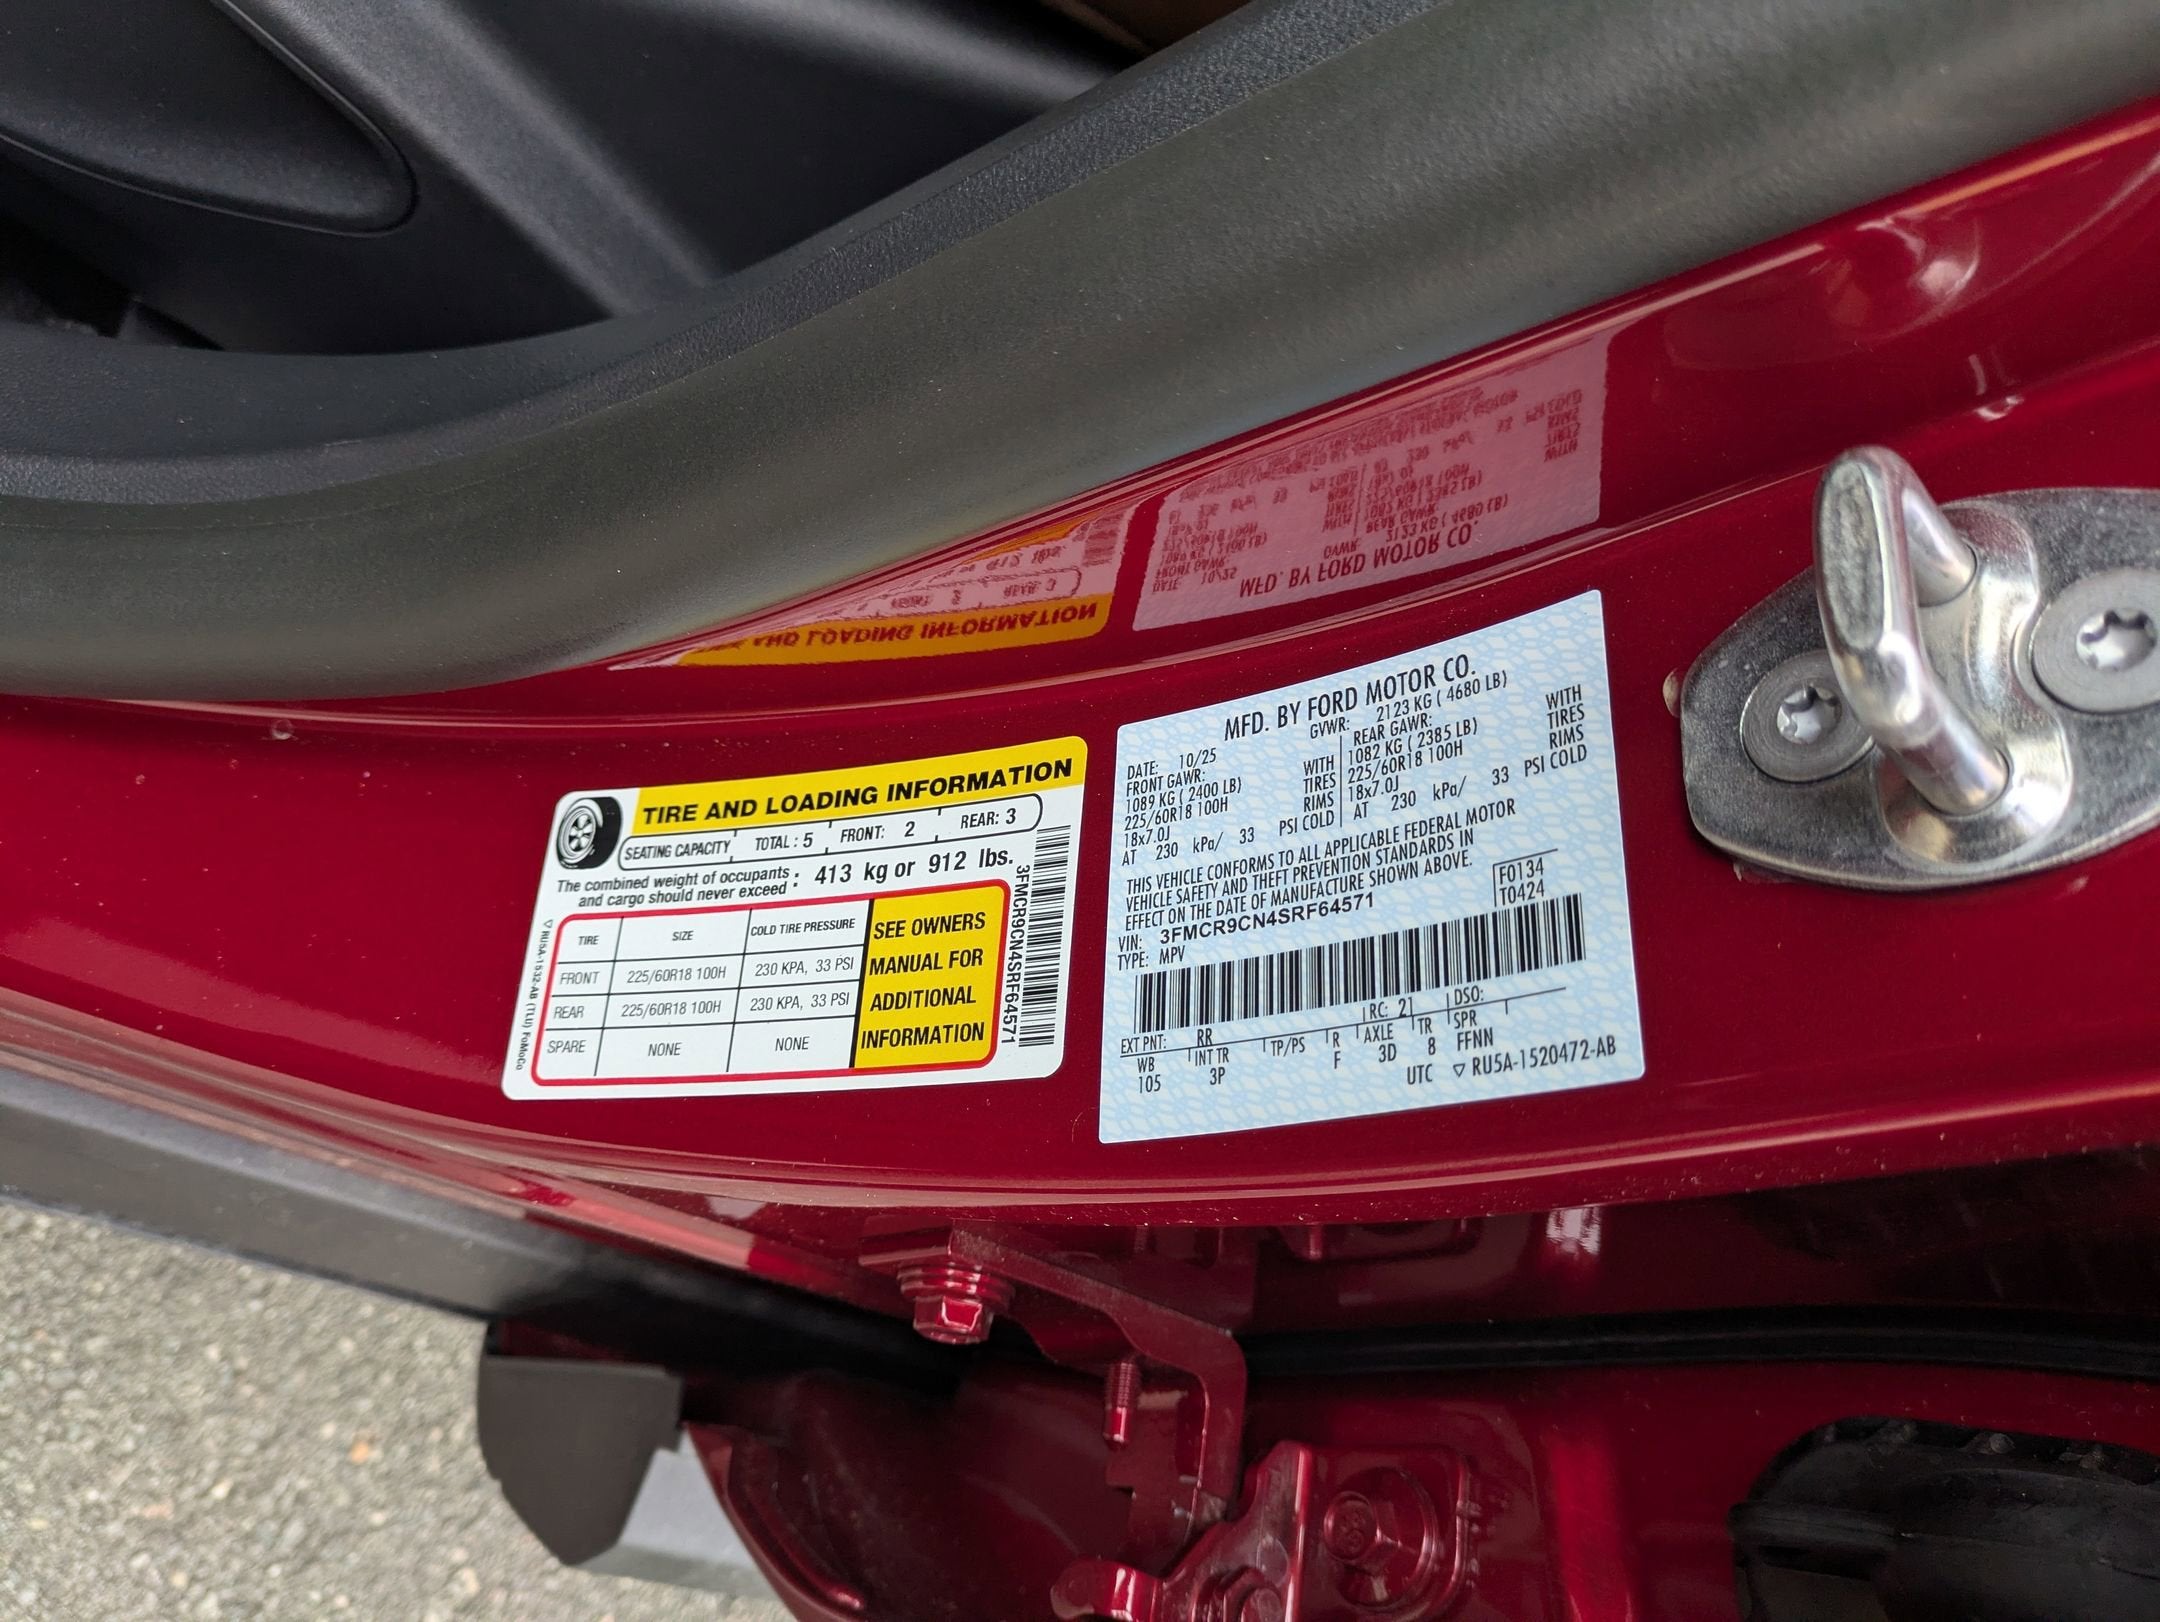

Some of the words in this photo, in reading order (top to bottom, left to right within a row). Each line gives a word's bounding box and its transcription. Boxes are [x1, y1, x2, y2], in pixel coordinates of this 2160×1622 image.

[1224, 711, 1269, 741] MFD.
[1278, 701, 1301, 728] BY
[1308, 687, 1358, 721] FORD
[1366, 664, 1435, 705] MOTOR
[1443, 654, 1476, 682] CO.
[1310, 717, 1350, 739] GVWR:
[1377, 701, 1410, 723] 2123
[1414, 694, 1432, 710] KG
[1486, 670, 1507, 689] LB)
[1349, 745, 1380, 766] 1082
[1385, 738, 1402, 754] KG
[1456, 717, 1477, 739] LB)
[1546, 684, 1582, 710] WITH
[1353, 724, 1385, 747] REAR
[1390, 715, 1432, 738] GAWR:
[1348, 750, 1423, 784] 225/60R18
[1429, 739, 1463, 763] 100H
[1547, 703, 1584, 730] TIRES
[1128, 761, 1158, 780] DATE:
[1180, 748, 1216, 769] 10/25
[1349, 775, 1400, 802] 18x7.0J
[1549, 724, 1584, 750] RIMS
[1127, 776, 1164, 797] FRONT
[1167, 770, 1205, 788] GAWR:
[1127, 795, 1155, 814] 1089
[1159, 792, 1176, 807] KG
[1223, 777, 1241, 794] LB)
[1303, 755, 1335, 776] WITH
[1391, 791, 1416, 811] 230
[1433, 776, 1466, 800] kPa/
[1492, 767, 1509, 786] 33
[1524, 756, 1545, 777] PSI
[1549, 744, 1587, 769] COLD
[643, 804, 699, 824] TIRE
[705, 800, 757, 820] AND
[765, 786, 878, 815] LOADING
[887, 758, 1072, 802] INFORMATION
[1124, 805, 1192, 831] 225/60R18
[1199, 799, 1228, 816] 100H
[1303, 773, 1336, 794] TIRES
[961, 811, 999, 829] REAR:
[1006, 808, 1016, 824] 3
[1125, 827, 1170, 848] 18x7.0J
[1303, 792, 1334, 812] RIMS
[803, 833, 813, 848] 5
[840, 825, 884, 843] FRONT:
[904, 821, 915, 837] 2
[1156, 842, 1178, 860] 230
[1193, 832, 1223, 853] kPa/
[1239, 827, 1255, 844] 33
[1279, 816, 1298, 836] PSI
[1303, 810, 1335, 831] COLD
[625, 845, 673, 861] SEATING
[675, 840, 731, 857] CAPACITY
[1127, 877, 1152, 895] THIS
[1157, 867, 1203, 889] VEHICLE
[1207, 853, 1274, 881] CONFORMS
[1278, 851, 1294, 866] TO
[1299, 845, 1320, 864] ALL
[1324, 825, 1400, 860] APPLICABLE
[1404, 812, 1461, 841] FEDERAL
[1466, 798, 1515, 825] MOTOR
[557, 880, 581, 892] The
[584, 876, 648, 890] combined
[654, 873, 699, 889] weight
[703, 871, 717, 884] of
[719, 866, 790, 885] occupants
[815, 863, 852, 885] 413
[864, 861, 888, 883] kg
[895, 860, 915, 878] or
[929, 851, 967, 873] 912
[979, 848, 1013, 868] lbs.
[1126, 890, 1172, 913] VEHICLE
[1176, 882, 1218, 904] SAFETY
[1222, 876, 1247, 896] AND
[1253, 869, 1288, 890] THEFT
[1293, 849, 1371, 883] PREVENTION
[1375, 834, 1455, 865] STANDARDS
[1460, 828, 1474, 846] IN
[1500, 858, 1544, 884] F0134
[579, 895, 602, 907] and
[607, 892, 644, 907] cargo
[649, 887, 692, 903] should
[697, 887, 734, 900] never
[739, 881, 787, 897] exceed
[1126, 910, 1163, 931] EFFECT
[1168, 907, 1185, 924] ON
[1190, 902, 1212, 920] THE
[1216, 896, 1246, 916] DATE
[1251, 892, 1267, 910] OF
[1271, 872, 1364, 907] MANUFACTURE
[1369, 861, 1419, 888] SHOWN
[1424, 850, 1472, 876] ABOVE.
[1500, 879, 1545, 905] T0424
[751, 925, 776, 936] COLD
[779, 922, 801, 935] TIRE
[803, 918, 855, 932] PRESSURE
[874, 920, 906, 939] SEE
[911, 912, 985, 936] OWNERS
[1119, 934, 1142, 952] VIN:
[1160, 892, 1373, 944] 3FMCR9CN4SRF64571
[578, 936, 600, 945] TIRE
[672, 931, 693, 941] SIZE
[869, 952, 943, 975] MANUAL
[949, 949, 983, 969] FOR
[1001, 864, 1031, 1044] 3FMCR9CN4SRF64571
[1118, 951, 1149, 971] TYPE:
[1160, 945, 1185, 965] MPV
[560, 971, 600, 985] FRONT
[627, 968, 692, 985] 225/60R18
[696, 967, 726, 980] 100H
[755, 963, 778, 976] 230
[750, 997, 773, 1011] 230
[870, 986, 976, 1012] ADDITIONAL
[1455, 986, 1484, 1005] DSO:
[522, 1002, 536, 1028] (TLU)
[554, 1006, 584, 1018] REAR
[621, 1003, 687, 1019] 225/60R18
[692, 1001, 721, 1014] 100H
[1369, 1002, 1388, 1020] RC:
[1454, 1010, 1477, 1029] SPR
[861, 1022, 985, 1049] INFORMATION
[1121, 1037, 1140, 1054] EXT
[1143, 1035, 1166, 1050] PNT:
[1197, 1029, 1212, 1047] RR
[1364, 1023, 1394, 1044] AXLE
[1457, 1028, 1493, 1051] FFNN
[516, 1032, 531, 1070] FoMoCo
[547, 1040, 586, 1054] SPARE
[648, 1042, 682, 1057] NONE
[1195, 1048, 1213, 1066] INT
[1271, 1037, 1305, 1057] TP/PS
[1379, 1043, 1397, 1062] 3D
[1407, 1063, 1433, 1085] UTC
[1472, 1035, 1616, 1076] RU5A-1520472-AB
[1137, 1057, 1155, 1073] WB
[1210, 1067, 1225, 1085] 3P
[1139, 1075, 1161, 1093] 105
